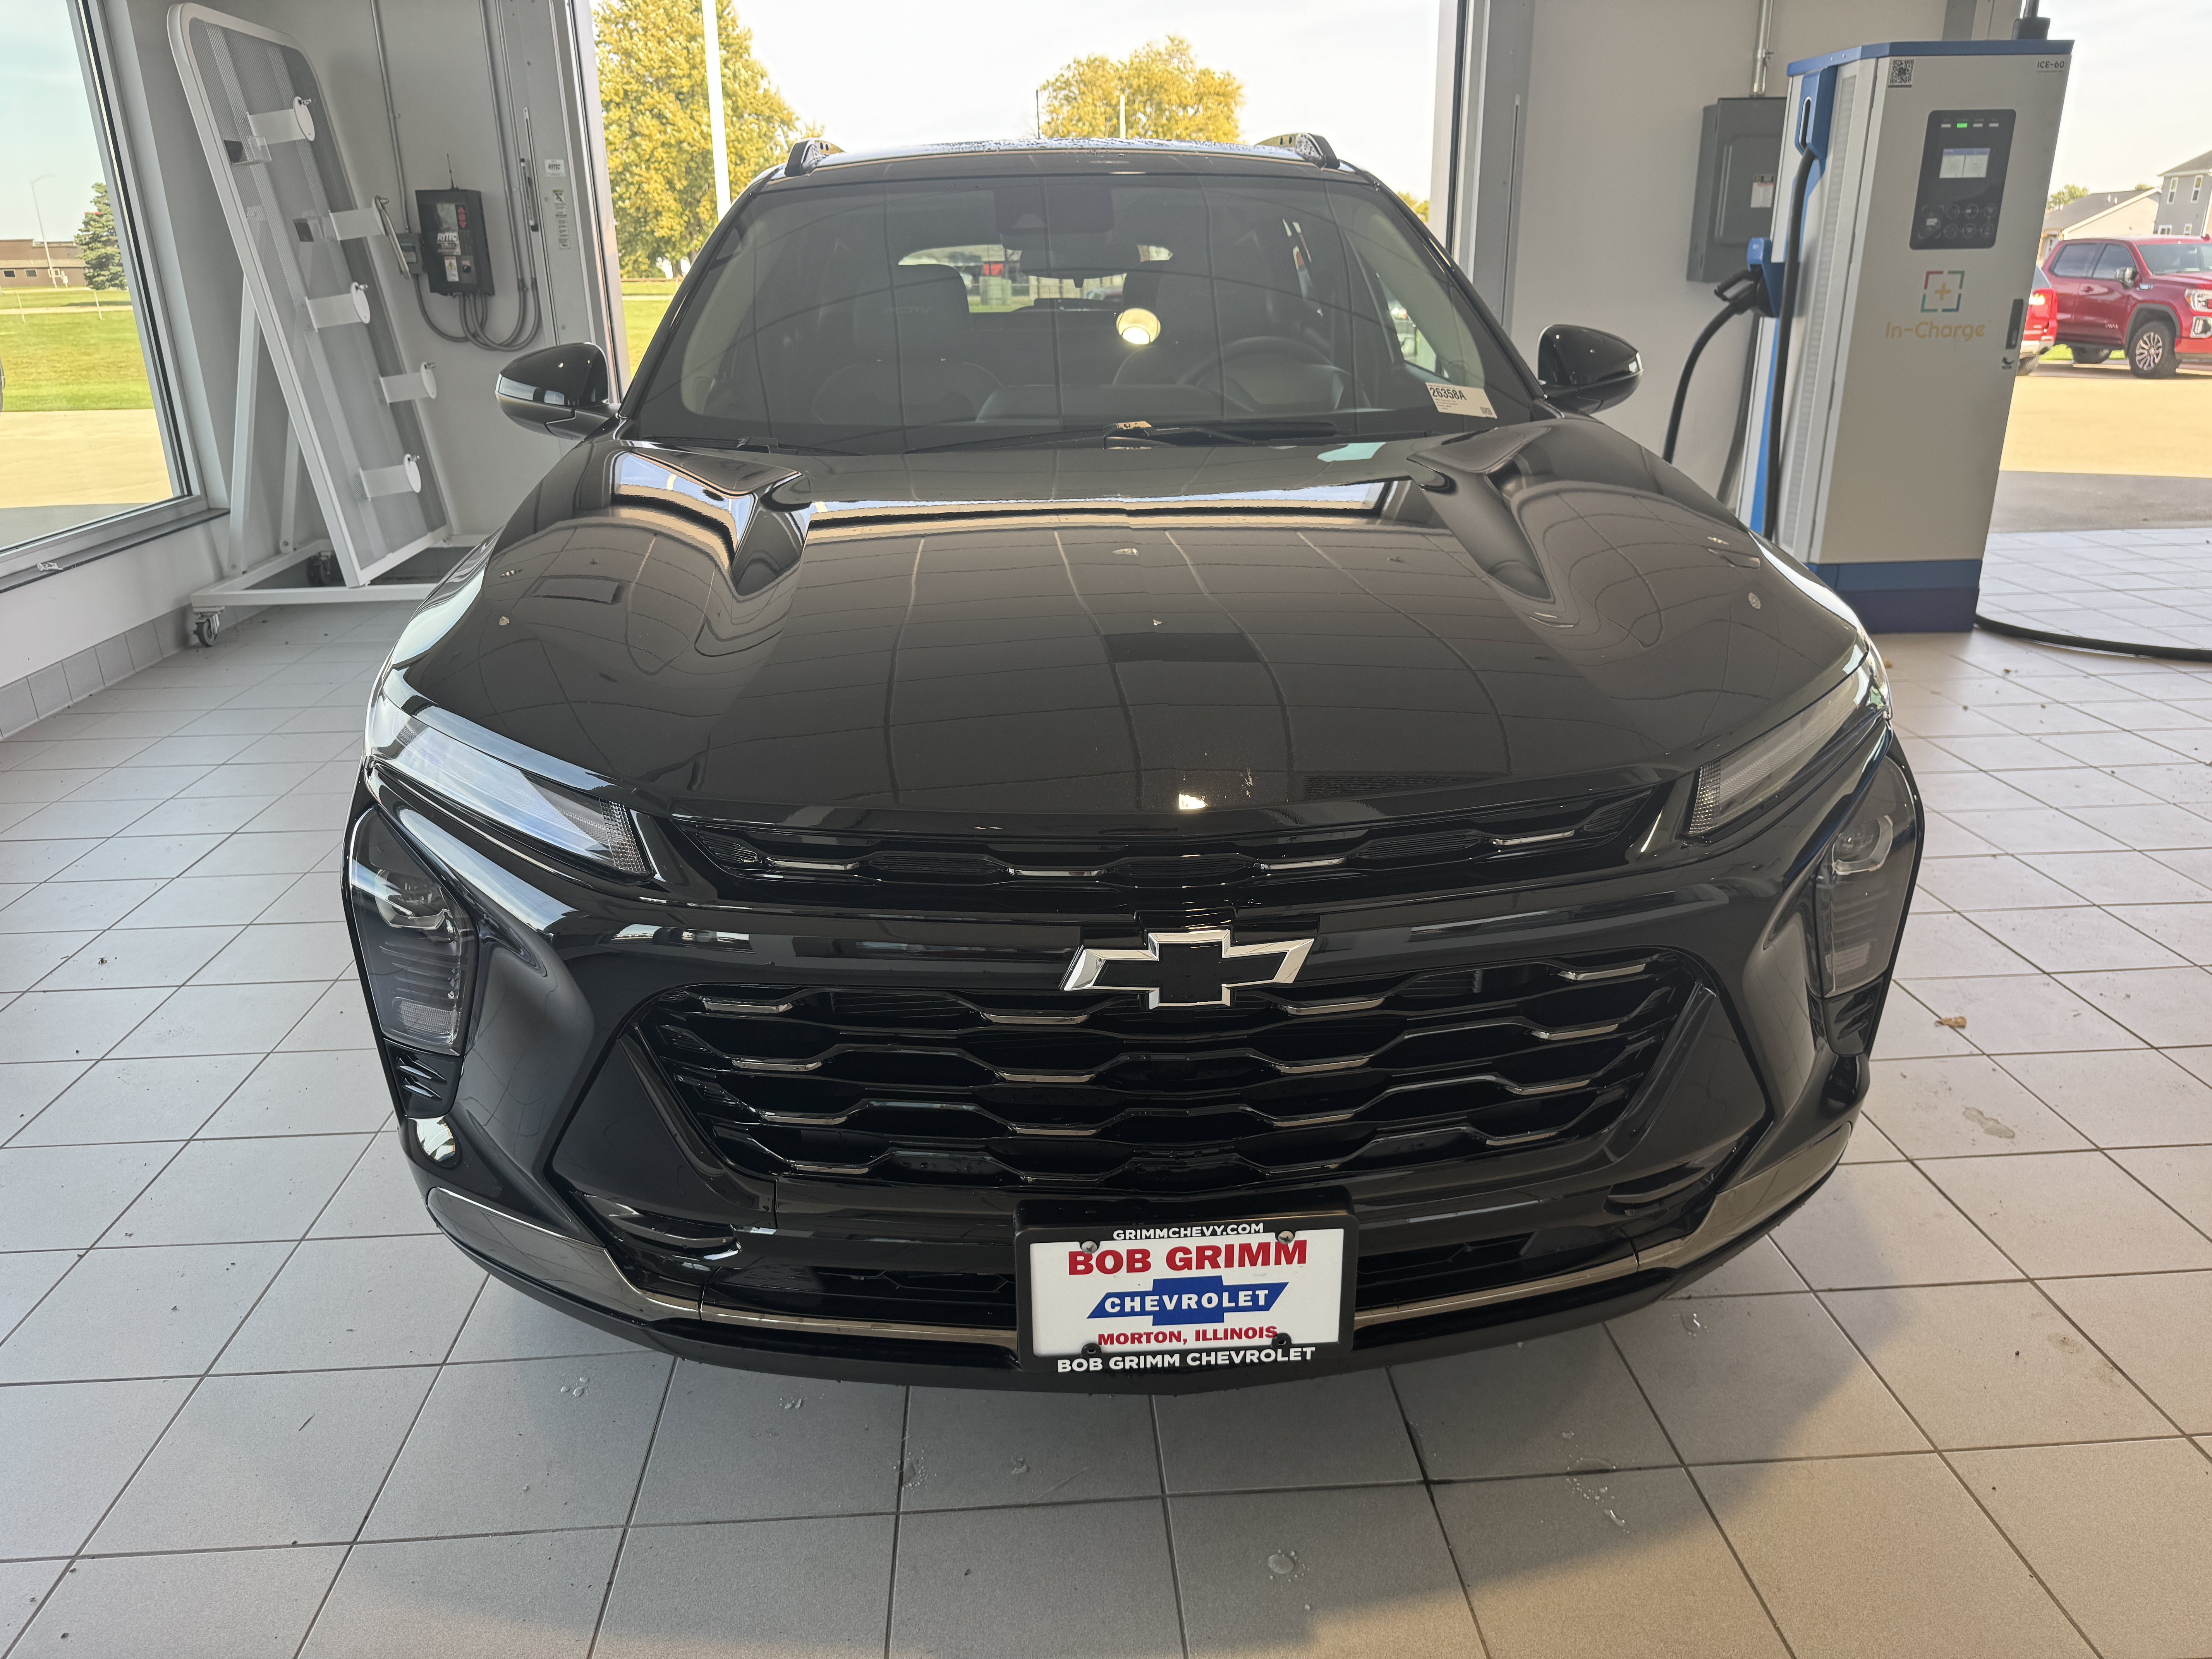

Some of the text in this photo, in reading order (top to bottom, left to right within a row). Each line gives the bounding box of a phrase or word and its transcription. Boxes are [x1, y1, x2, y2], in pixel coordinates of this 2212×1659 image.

[2037, 60, 2065, 69] ICE-60
[437, 232, 457, 242] RYTEC
[1885, 321, 1986, 342] In-Charge
[1430, 387, 1467, 400] 26358A
[1113, 1223, 1264, 1240] GRIMMCHEVY.COM
[1068, 1240, 1307, 1276] BOB GRIMM
[1104, 1290, 1269, 1313] CHEVROLET
[1098, 1326, 1277, 1345] MORTON, ILLINOIS
[1058, 1347, 1316, 1372] BOB GRIMM CHEVROLET
